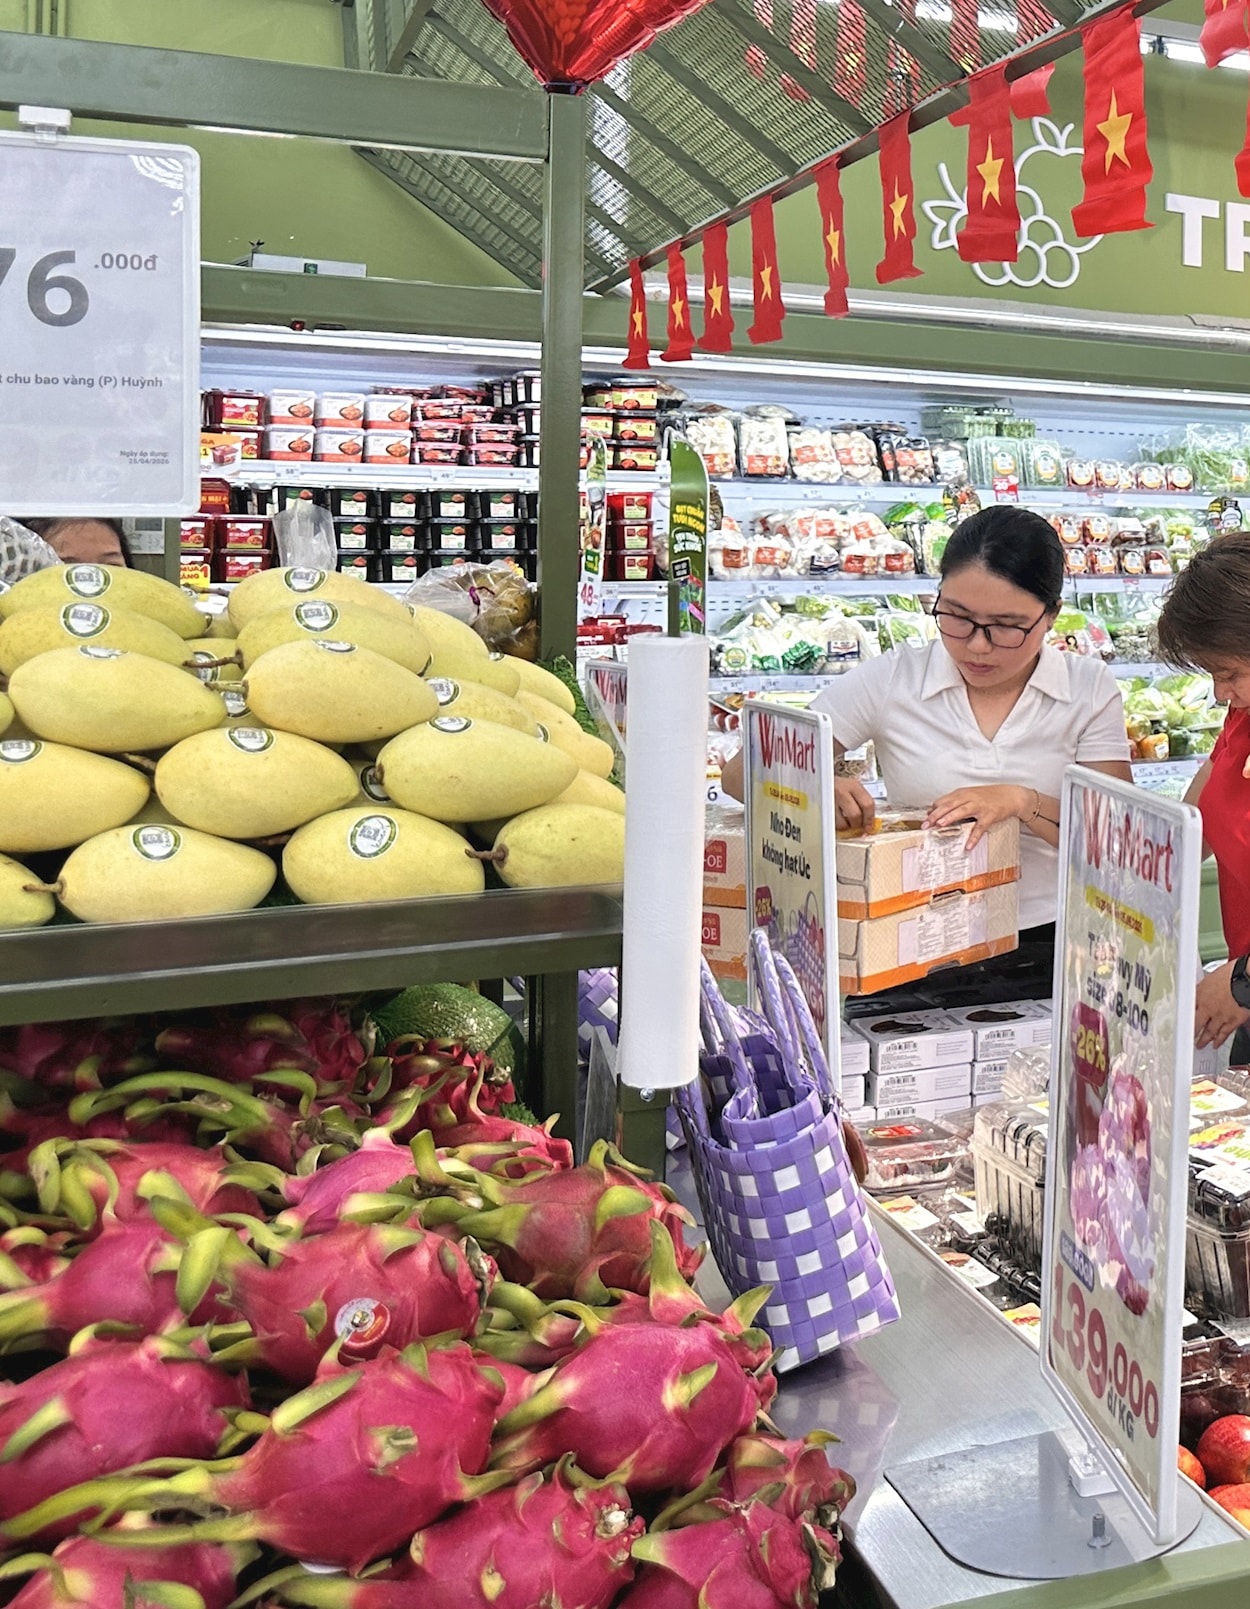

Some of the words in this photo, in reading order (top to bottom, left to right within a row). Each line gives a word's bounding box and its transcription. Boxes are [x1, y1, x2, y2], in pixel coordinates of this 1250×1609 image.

[7, 374, 31, 385] chu
[35, 373, 60, 386] bao
[63, 374, 95, 389] vàng
[98, 376, 119, 389] (P)
[121, 376, 164, 390] Huỳnh
[758, 711, 816, 774] WinMart
[770, 811, 784, 837] Nho
[784, 817, 801, 844] Đen
[1082, 787, 1174, 893] WinMart
[762, 837, 784, 875] không
[1053, 1261, 1159, 1440] 139.000
